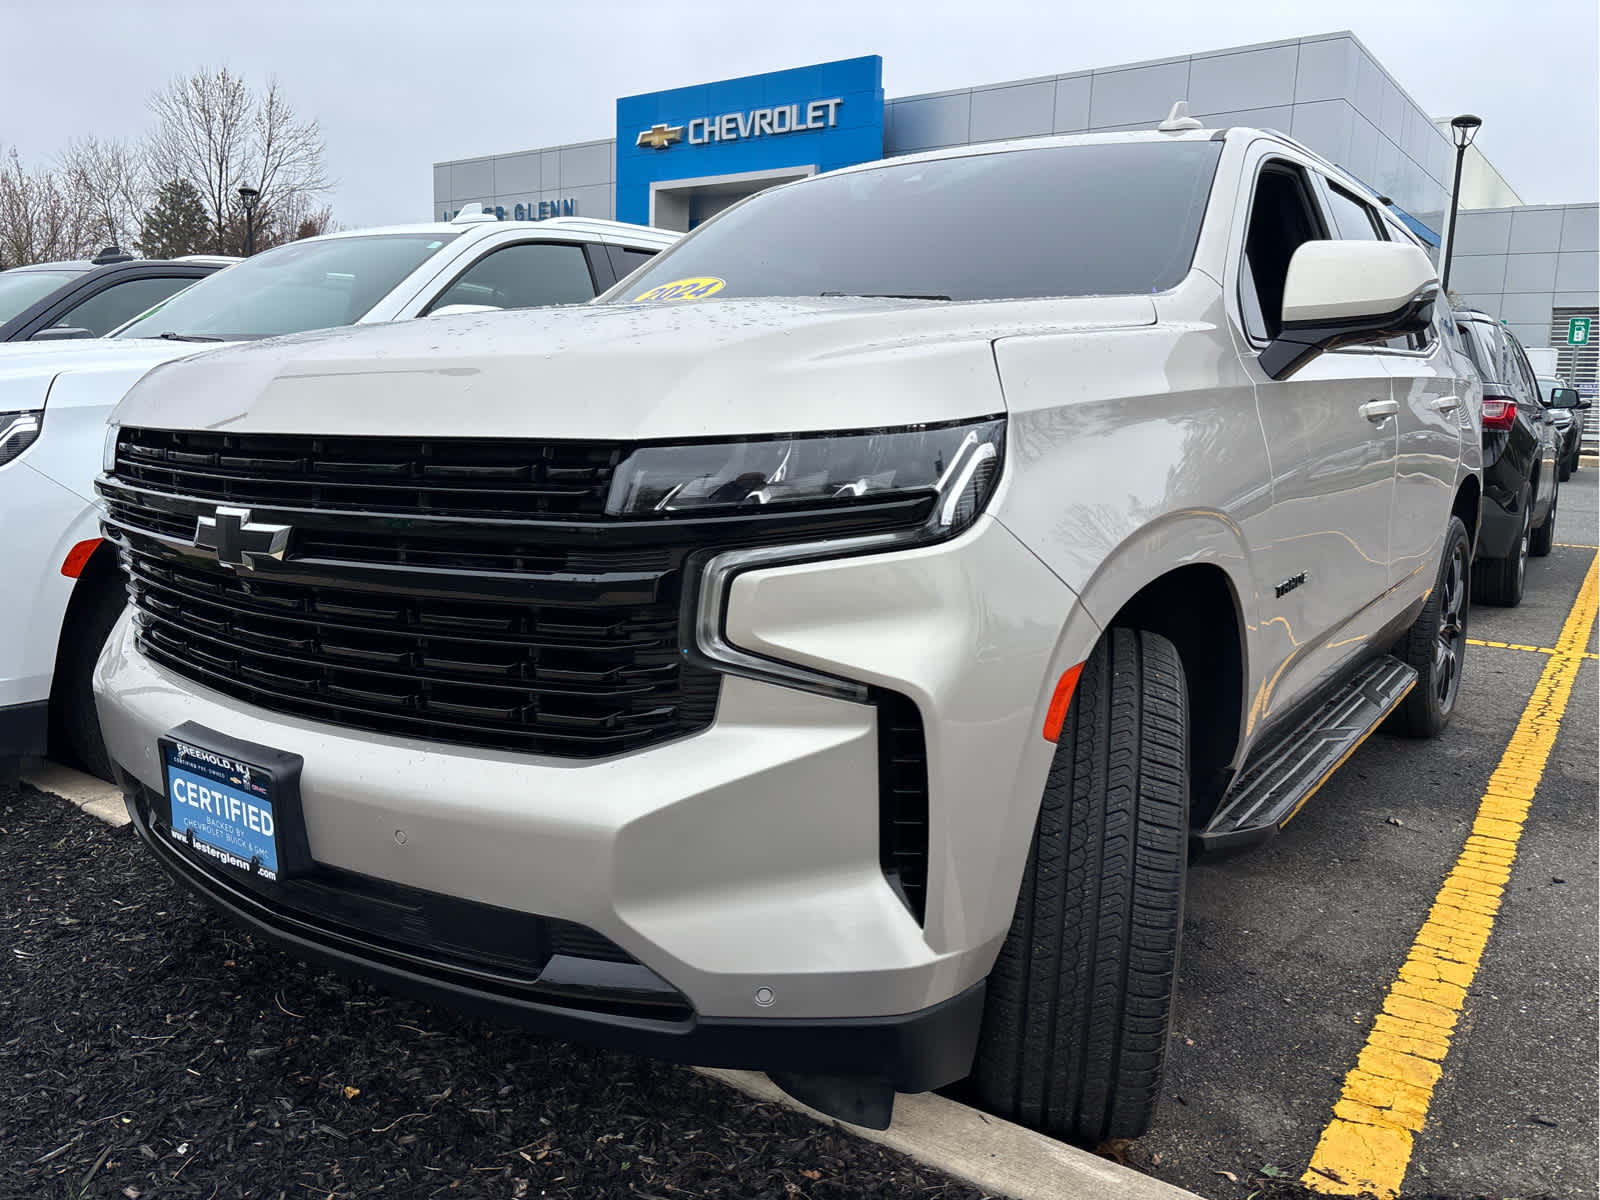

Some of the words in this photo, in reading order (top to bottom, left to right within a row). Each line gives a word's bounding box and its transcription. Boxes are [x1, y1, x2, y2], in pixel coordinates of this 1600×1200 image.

[689, 97, 844, 145] CHEVROLET
[514, 198, 574, 222] GLENN
[173, 777, 275, 837] CERTIFIED
[183, 817, 224, 839] CHEVROLET
[226, 833, 247, 849] BUICK
[206, 816, 233, 834] BACKED
